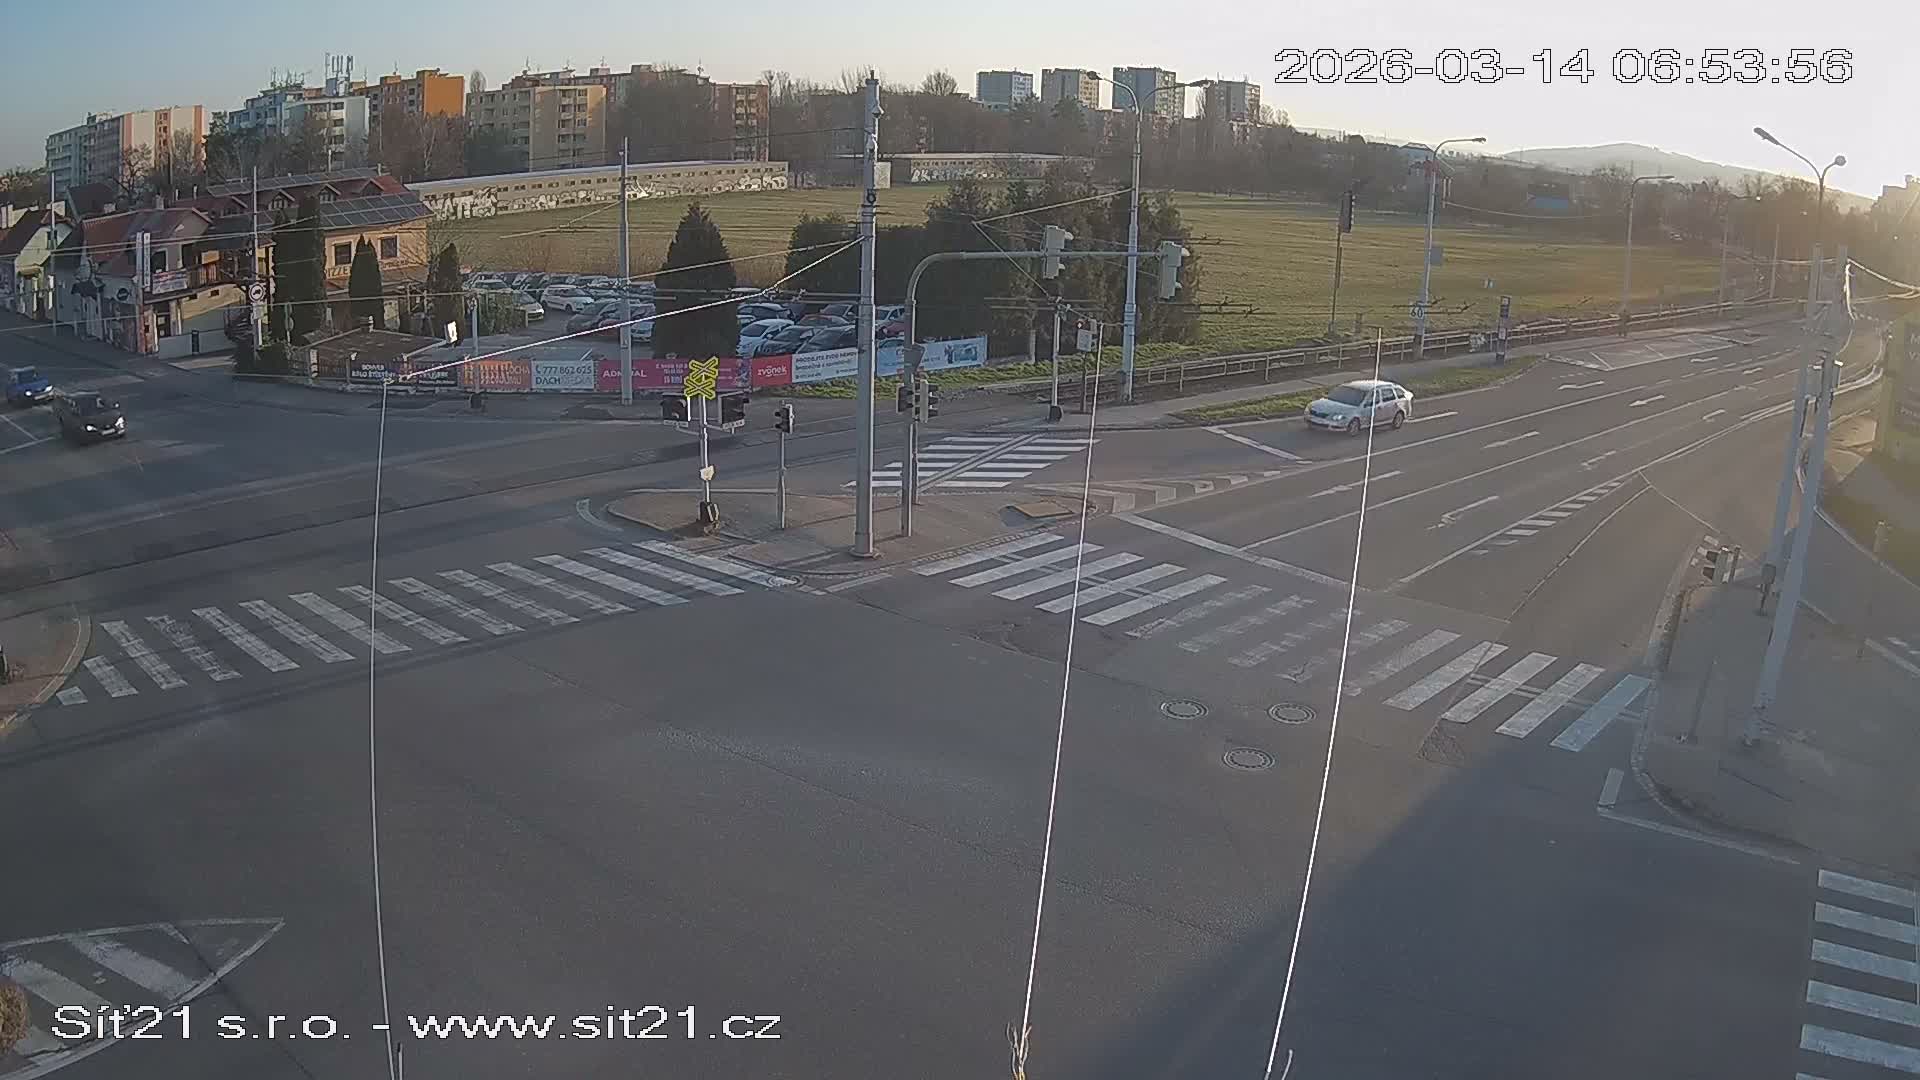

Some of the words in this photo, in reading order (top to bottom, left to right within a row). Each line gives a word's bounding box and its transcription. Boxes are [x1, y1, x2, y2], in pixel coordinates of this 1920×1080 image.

[1410, 308, 1424, 319] 60
[542, 365, 560, 374] 777
[560, 365, 575, 375] 862
